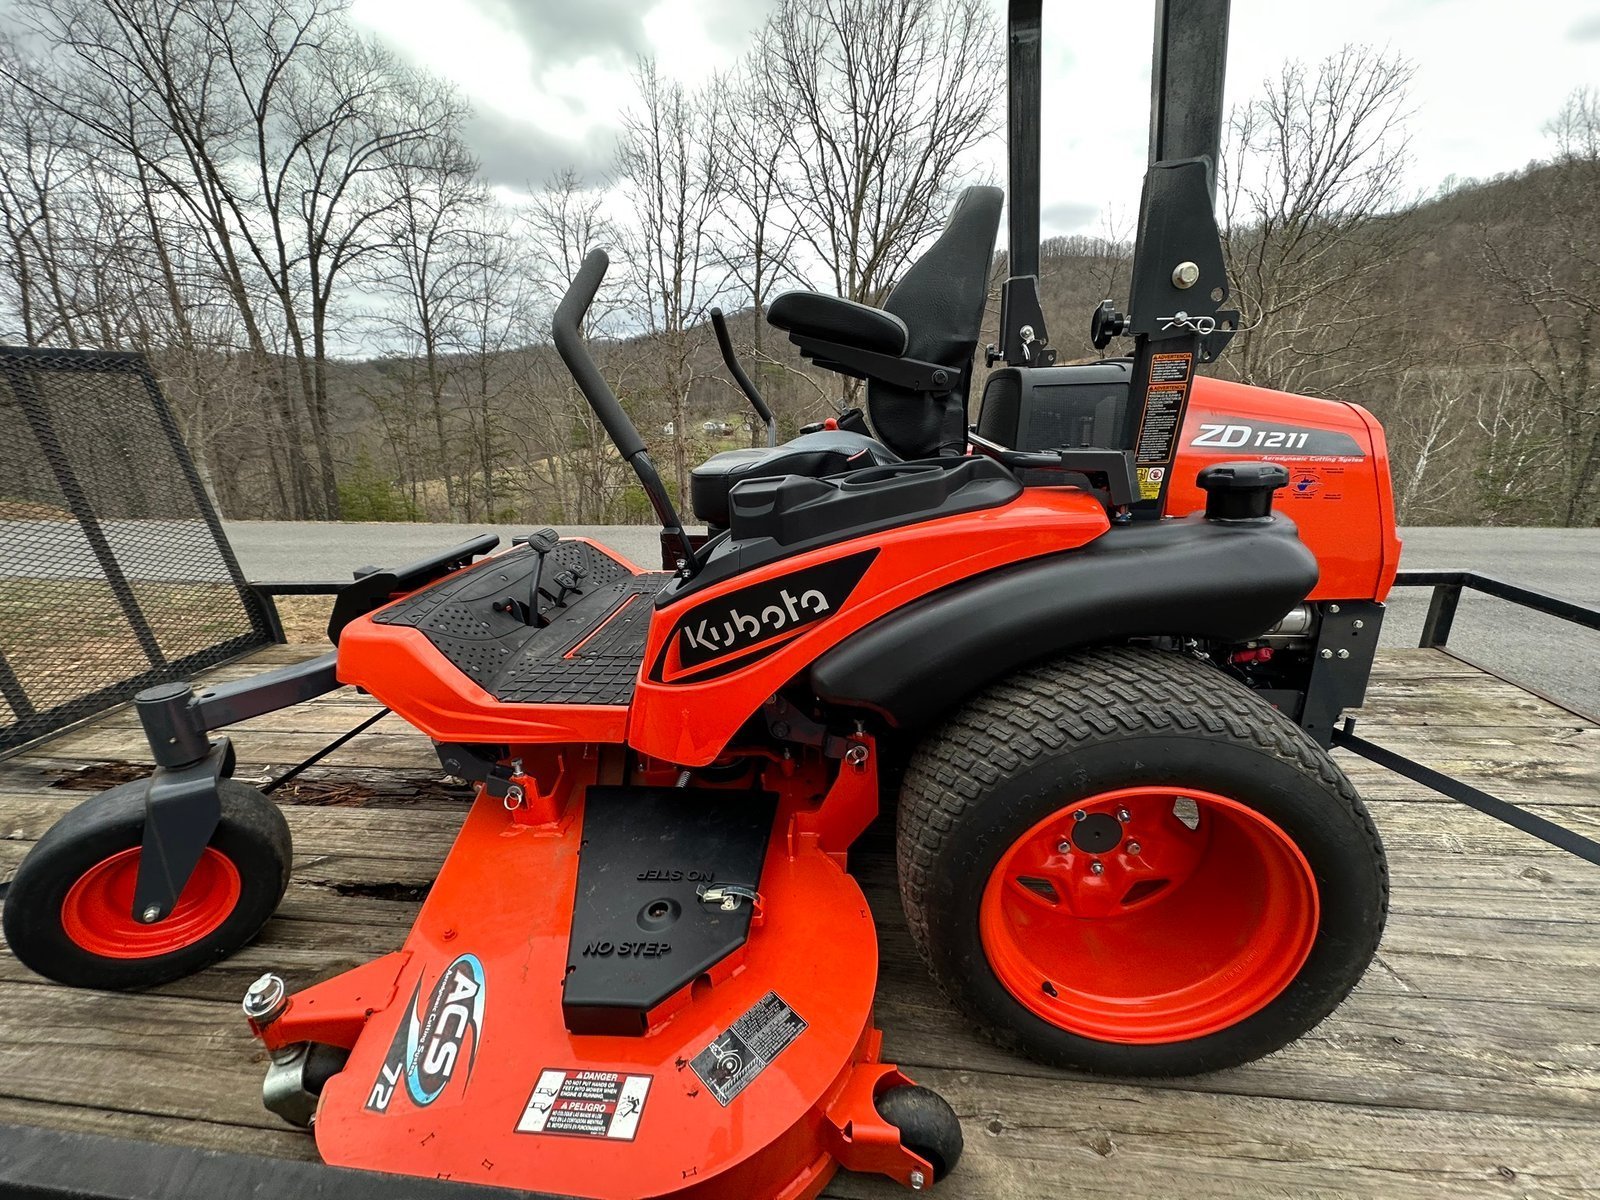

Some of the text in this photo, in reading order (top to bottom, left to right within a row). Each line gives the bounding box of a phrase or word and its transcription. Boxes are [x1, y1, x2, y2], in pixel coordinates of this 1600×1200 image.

[1190, 424, 1310, 449] ZD 1211
[684, 589, 830, 651] Kubota
[637, 869, 714, 883] NO STEP
[582, 941, 672, 957] NO STEP
[432, 969, 453, 1013] Aerodynamic
[420, 1013, 437, 1044] Cutting
[423, 970, 480, 1077] ACS
[367, 1062, 403, 1110] 72
[583, 1072, 618, 1081] DANGER
[569, 1101, 606, 1112] PELIGRO
